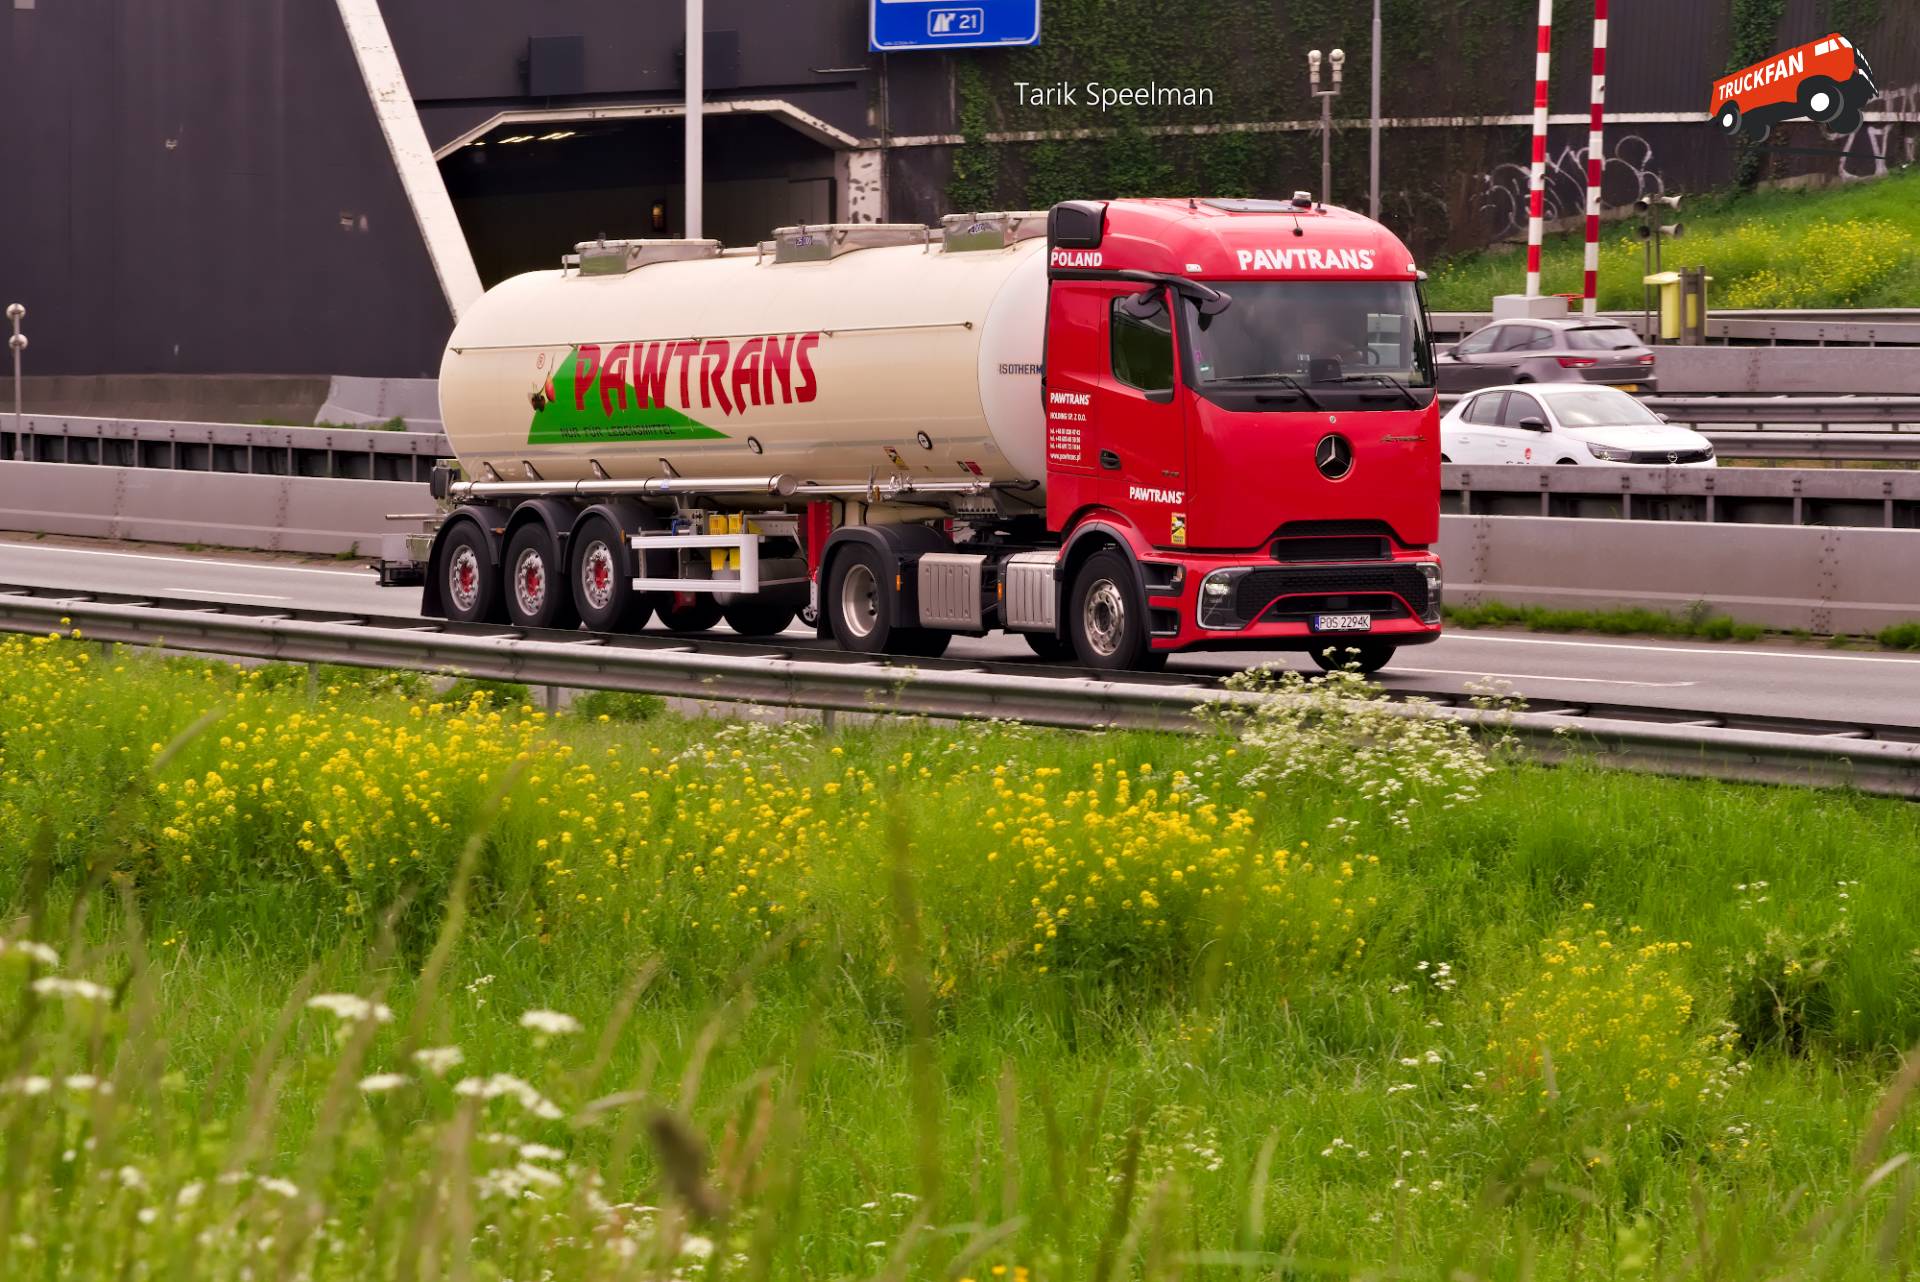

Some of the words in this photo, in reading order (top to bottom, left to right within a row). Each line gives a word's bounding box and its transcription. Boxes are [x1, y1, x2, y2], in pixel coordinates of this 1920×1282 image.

[959, 14, 977, 29] 21
[1050, 251, 1103, 267] POLAND
[573, 331, 820, 418] PAWTRANS
[560, 427, 579, 439] NUR
[607, 423, 677, 438] LEBENSMITTEL
[1320, 616, 1338, 629] POS
[1341, 615, 1369, 628] 2294K
